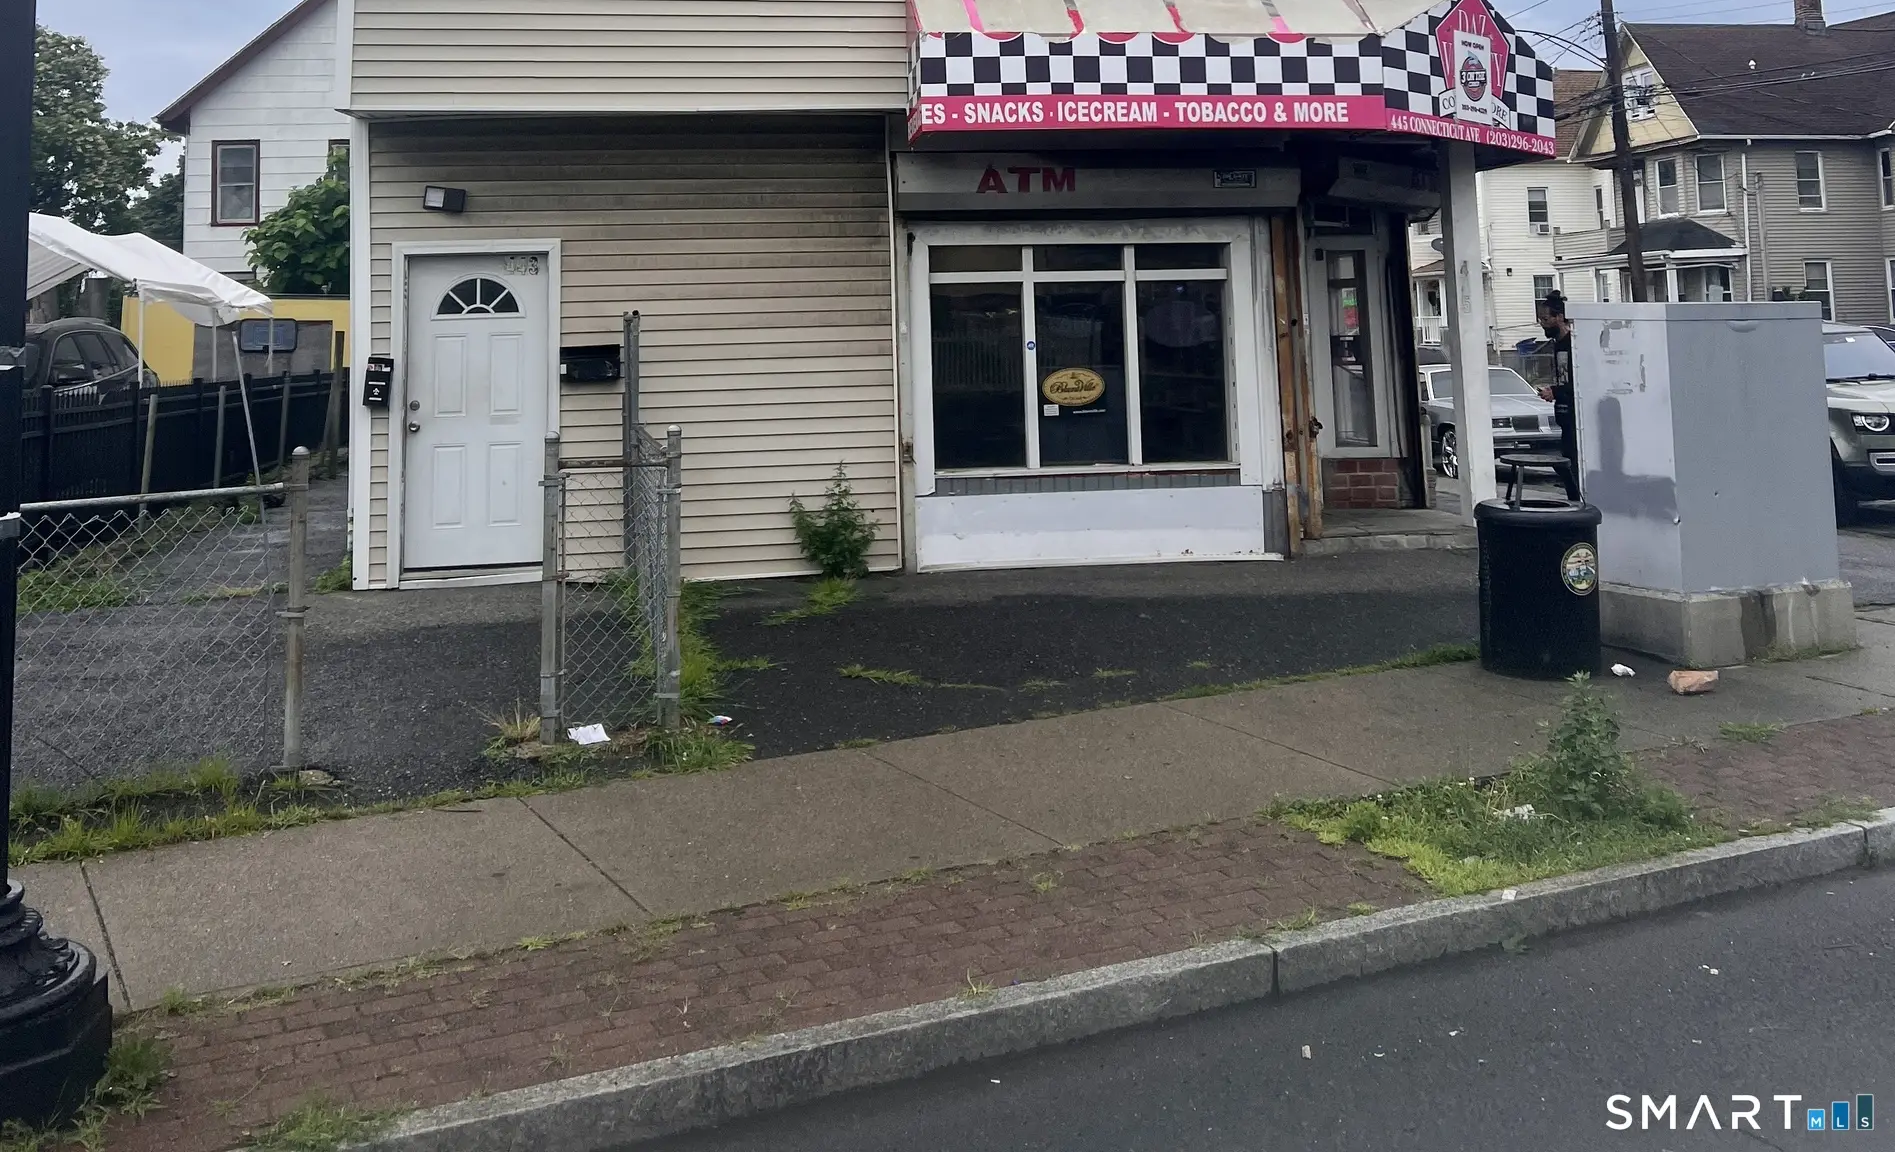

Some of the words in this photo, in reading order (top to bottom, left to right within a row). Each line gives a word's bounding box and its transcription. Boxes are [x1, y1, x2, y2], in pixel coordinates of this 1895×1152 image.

[964, 101, 1044, 124] SNACKS
[1057, 101, 1157, 123] ICECREAM
[1175, 101, 1266, 123] TOBACCO
[1273, 102, 1287, 123] &
[1293, 102, 1349, 123] MORE
[1390, 114, 1408, 132] 445
[1409, 116, 1465, 142] CONNECTICUT
[1465, 126, 1480, 143] AVE
[1486, 130, 1555, 155] (203)296-2043
[976, 165, 1076, 194] ATM
